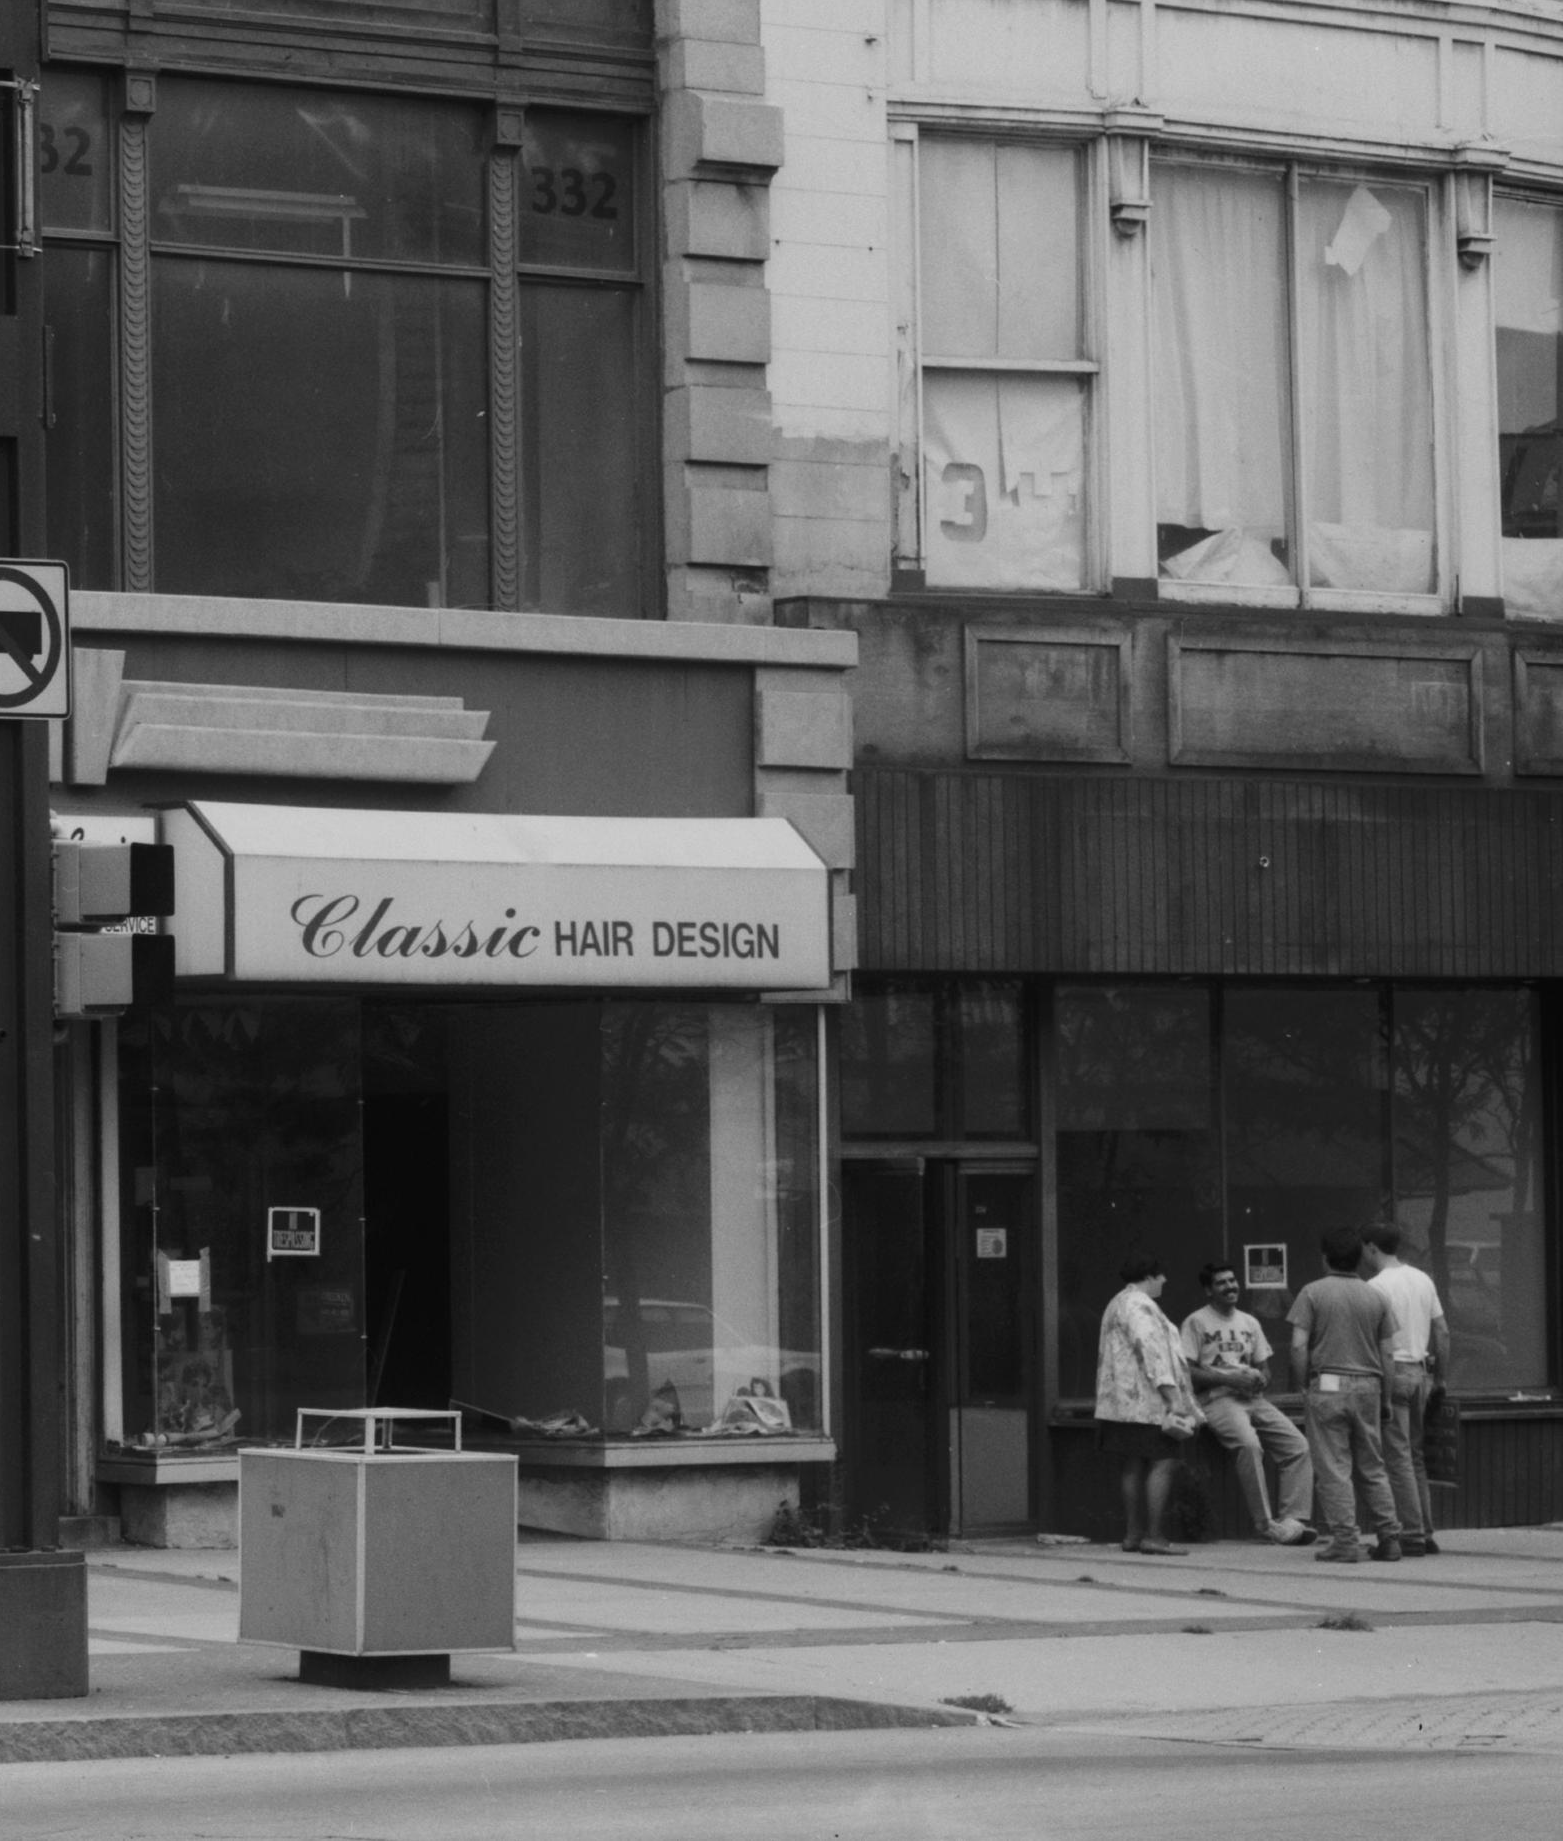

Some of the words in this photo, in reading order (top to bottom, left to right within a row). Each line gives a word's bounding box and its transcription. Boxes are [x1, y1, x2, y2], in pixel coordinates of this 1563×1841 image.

[531, 167, 618, 220] 332
[290, 894, 541, 958] Classic
[554, 920, 634, 957] HAIR
[652, 920, 779, 959] DESIGN
